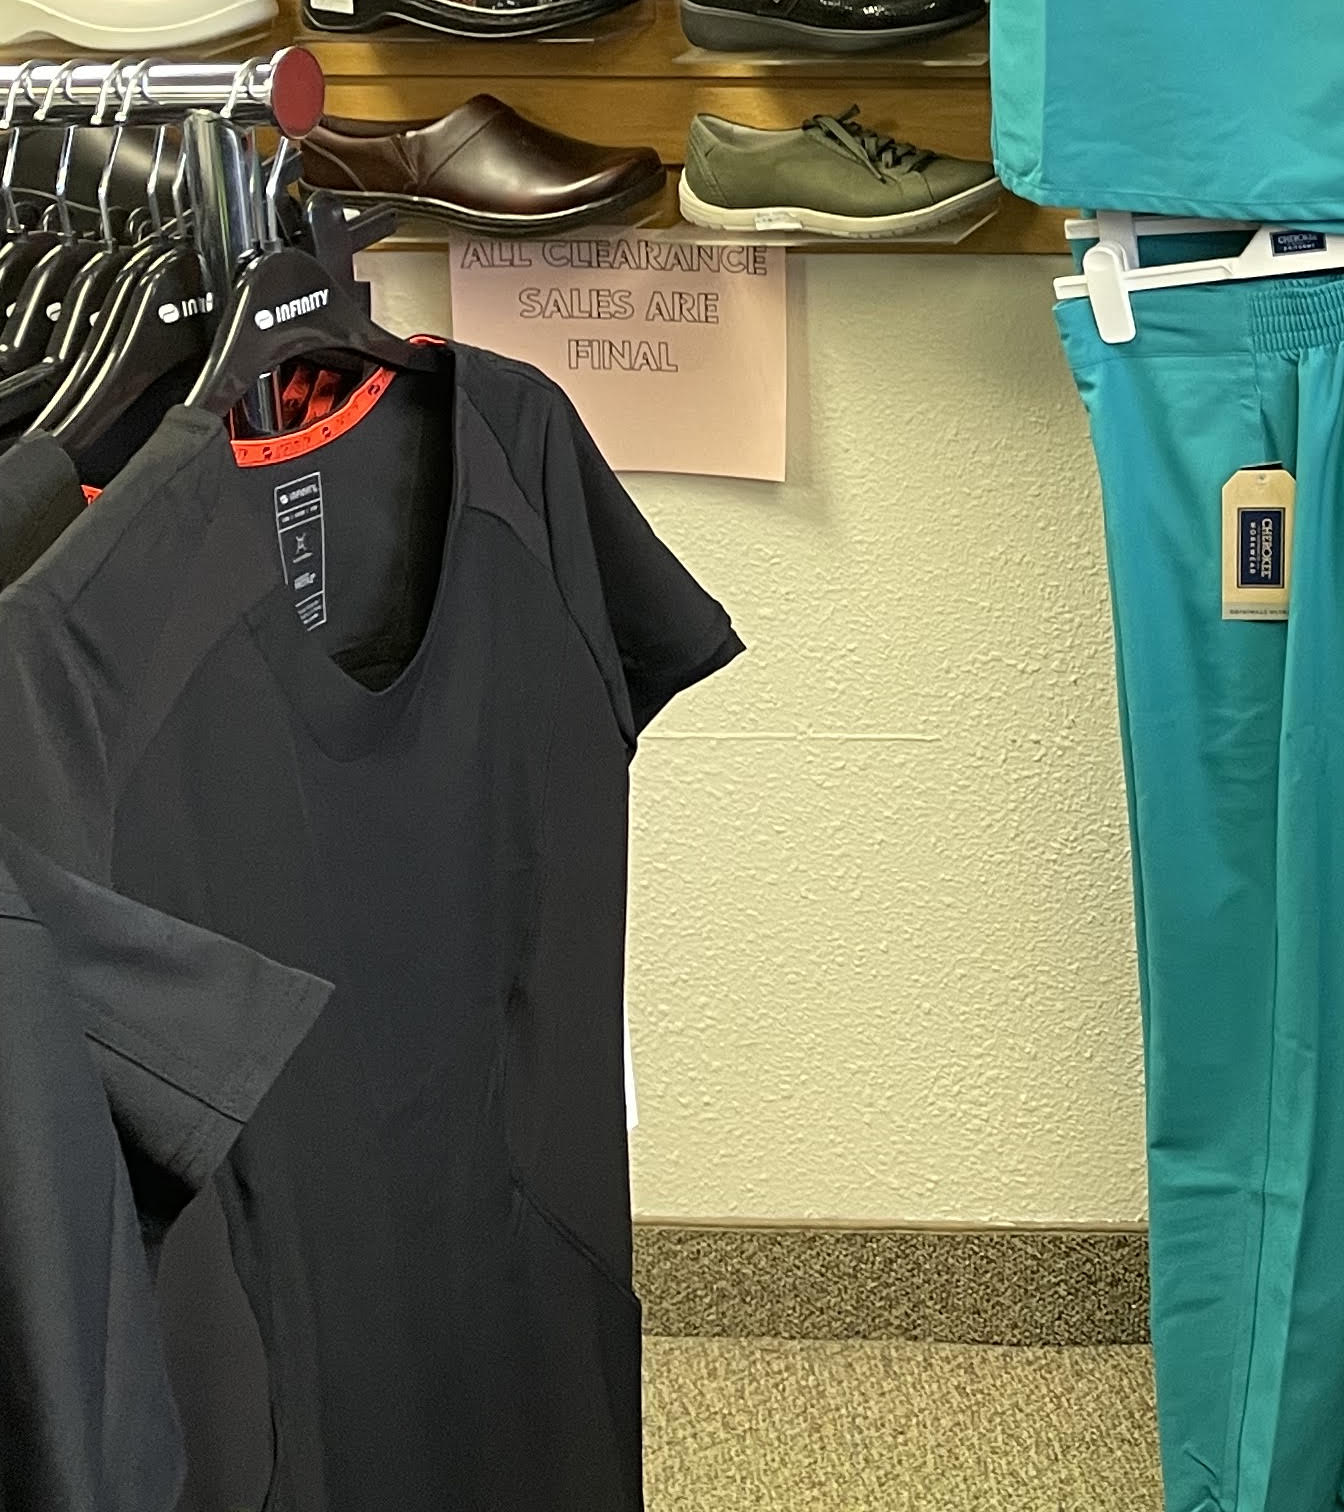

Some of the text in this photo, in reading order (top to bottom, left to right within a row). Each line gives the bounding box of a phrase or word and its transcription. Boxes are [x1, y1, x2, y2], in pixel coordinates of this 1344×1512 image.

[461, 238, 768, 276] ALL CLEARANCE
[275, 289, 329, 324] INFINITY
[518, 287, 720, 325] SALES ARE
[567, 339, 679, 373] FINAL
[1261, 518, 1272, 580] CHEROKEE
